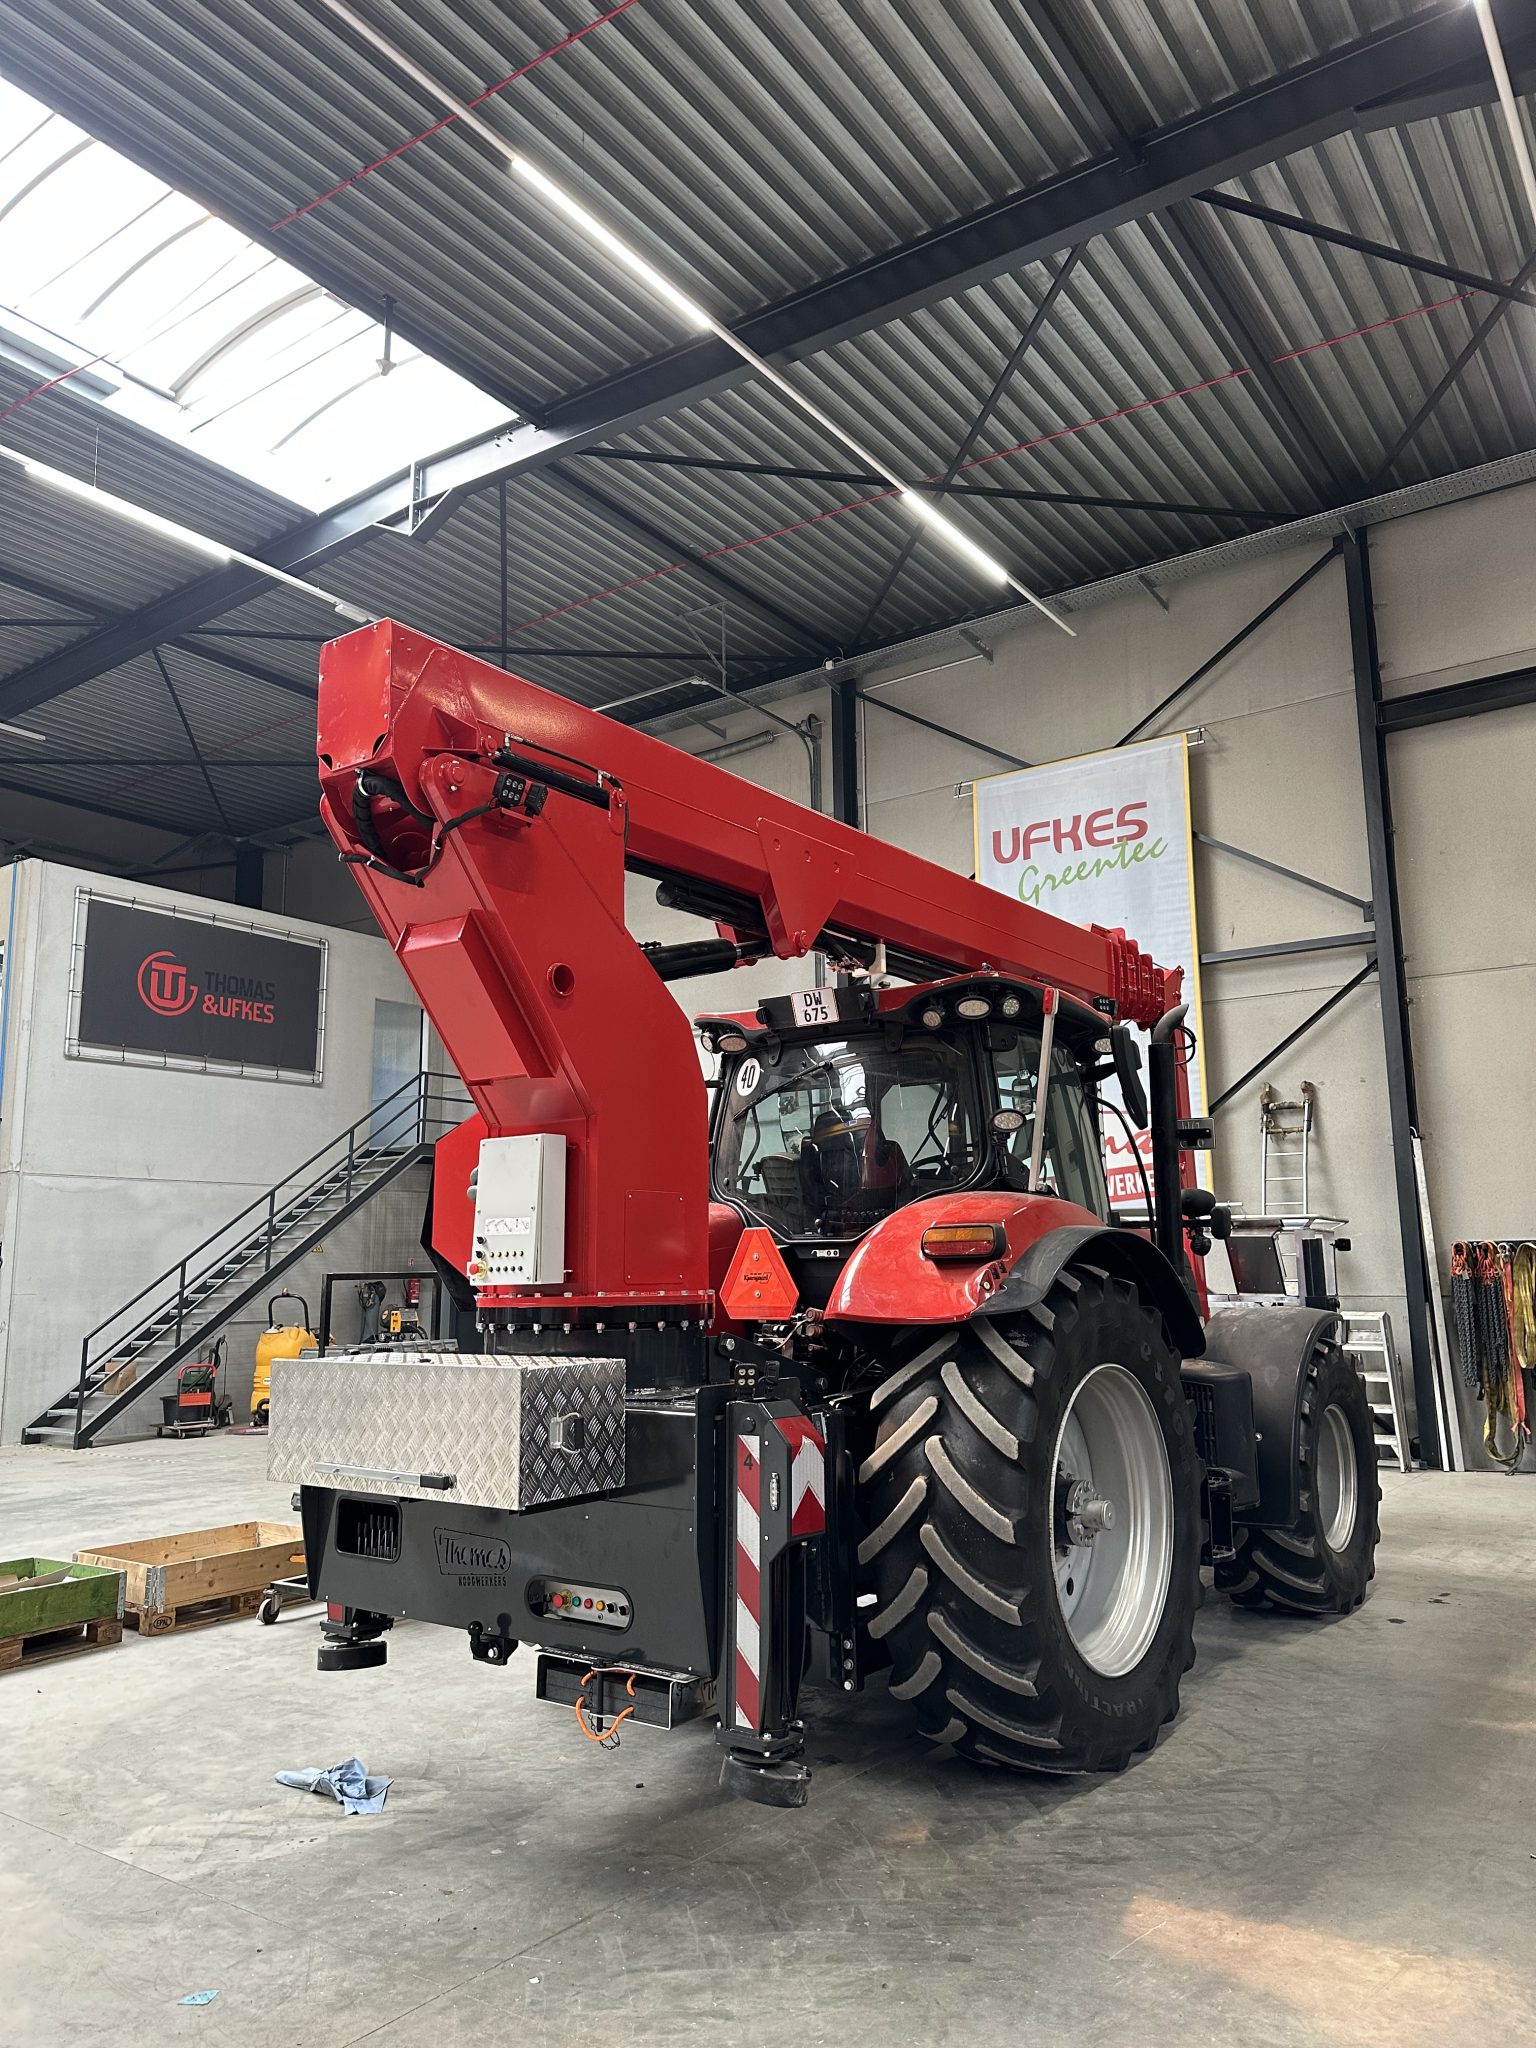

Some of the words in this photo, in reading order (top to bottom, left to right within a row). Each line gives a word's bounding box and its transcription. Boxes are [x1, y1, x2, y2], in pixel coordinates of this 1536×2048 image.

[992, 801, 1149, 864] UFKES
[1018, 837, 1169, 905] Greentec
[205, 971, 276, 1001] THOMAS
[803, 991, 822, 1007] DW
[202, 994, 275, 1024] &UFKES
[804, 1005, 829, 1022] 675
[741, 1064, 756, 1089] 40
[744, 1451, 753, 1470] 4
